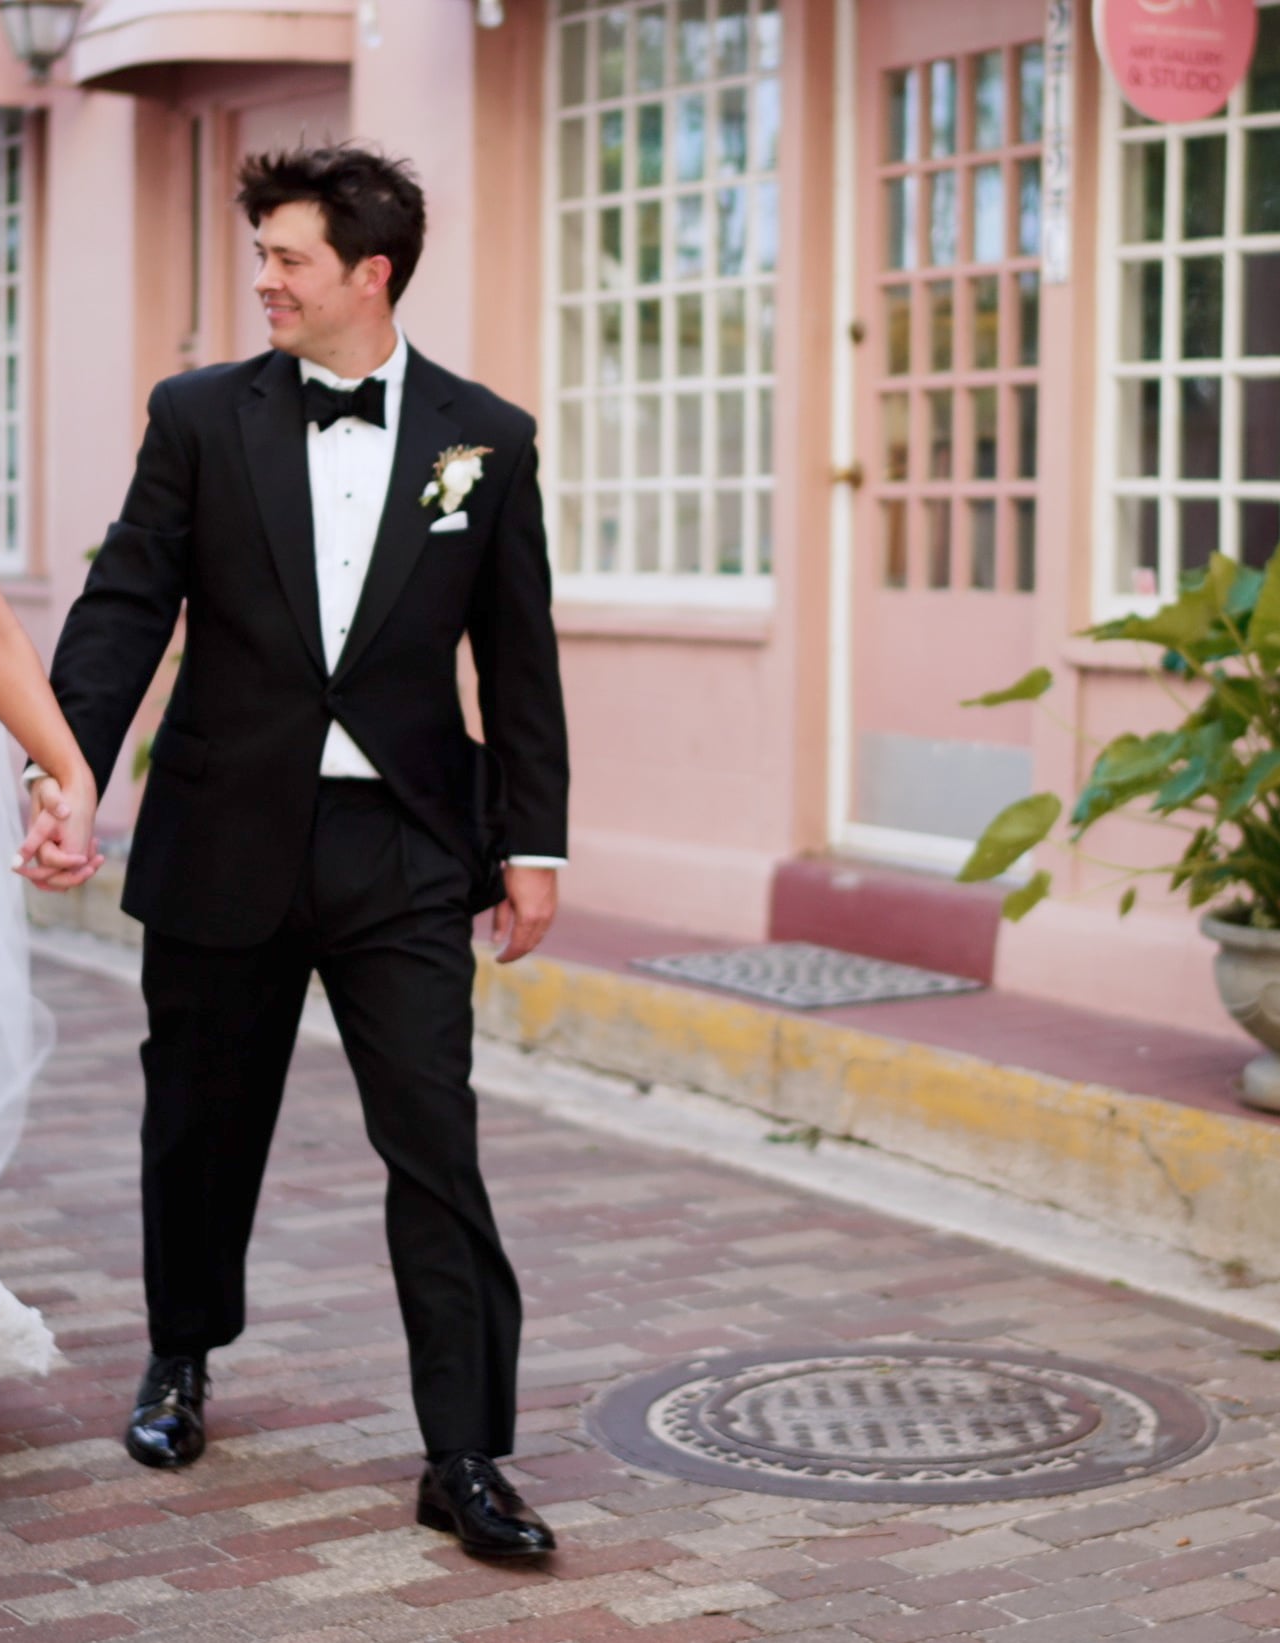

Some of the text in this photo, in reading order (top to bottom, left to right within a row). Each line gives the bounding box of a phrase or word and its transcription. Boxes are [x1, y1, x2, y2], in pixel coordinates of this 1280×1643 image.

[1160, 48, 1224, 66] GALLERY
[1127, 65, 1222, 94] & STUDIO
